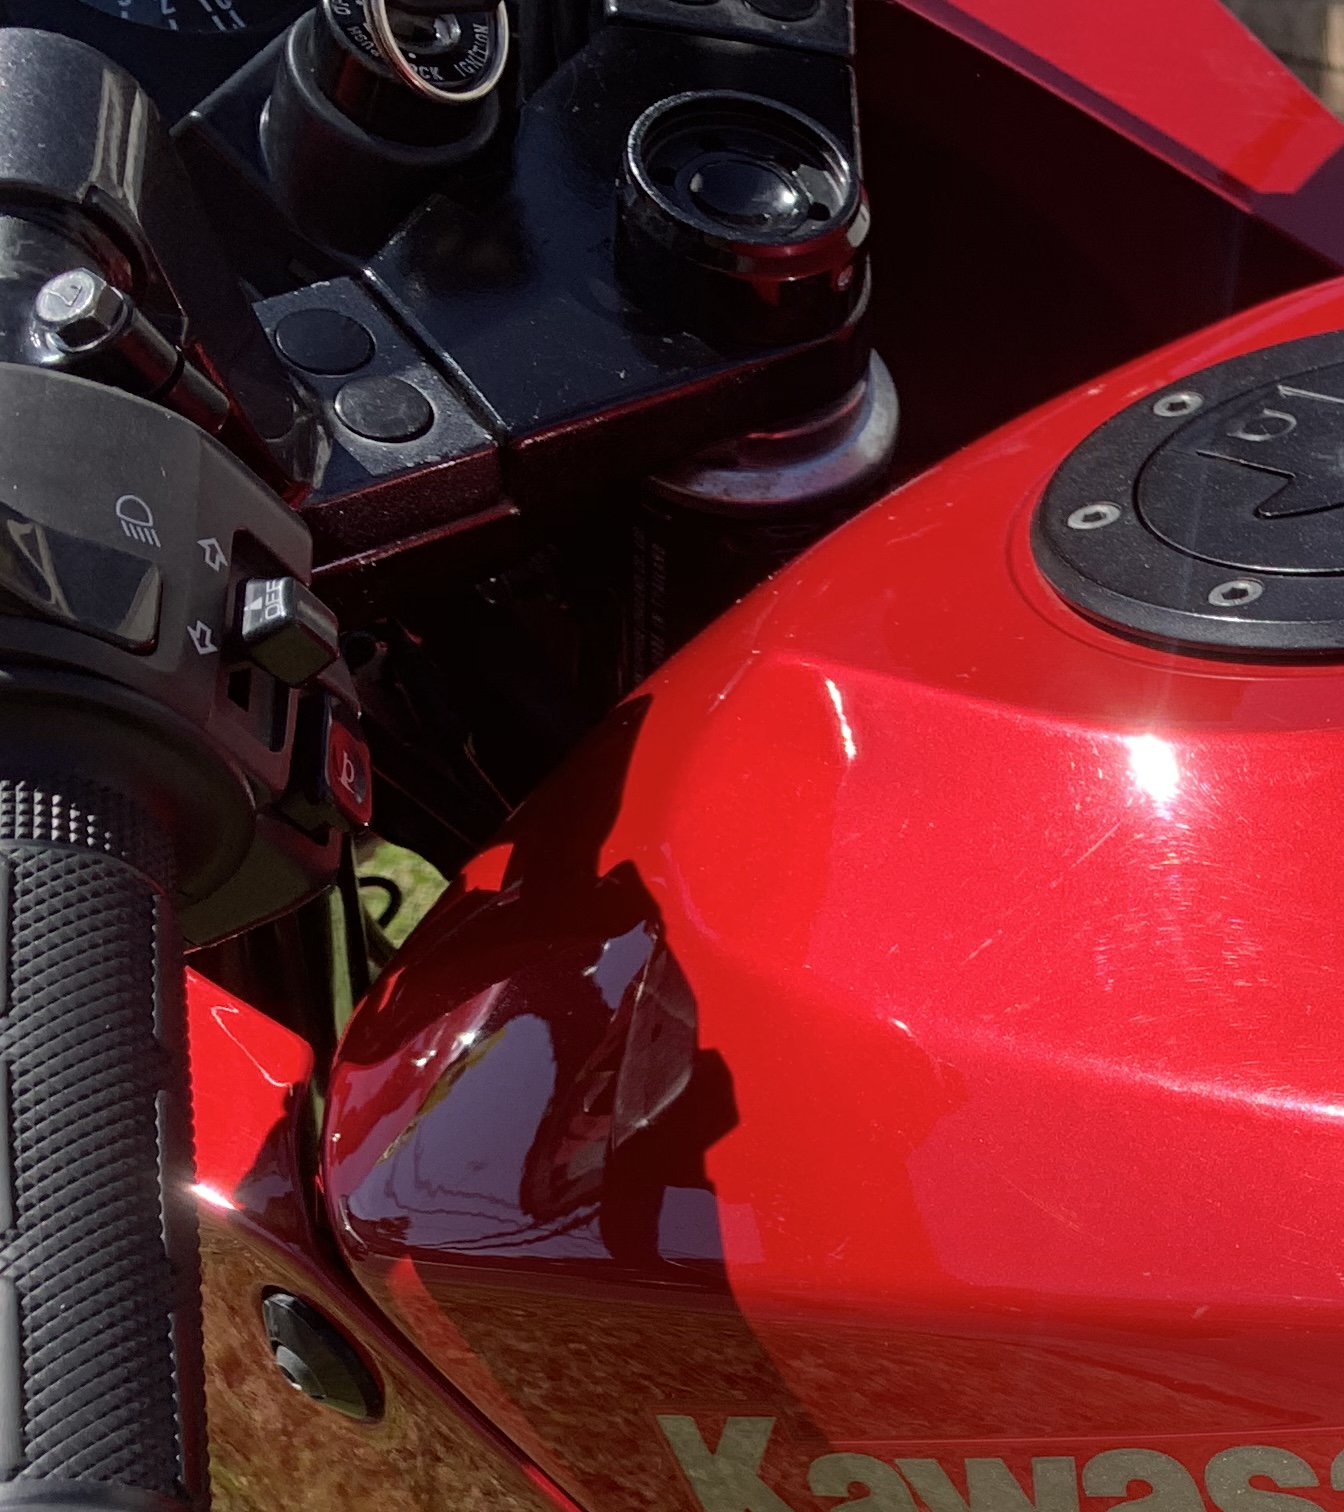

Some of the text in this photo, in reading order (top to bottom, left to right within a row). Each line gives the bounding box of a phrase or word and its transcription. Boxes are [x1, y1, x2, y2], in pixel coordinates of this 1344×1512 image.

[454, 23, 489, 77] IGNITION
[408, 63, 445, 81] OCK
[265, 579, 283, 620] OFF
